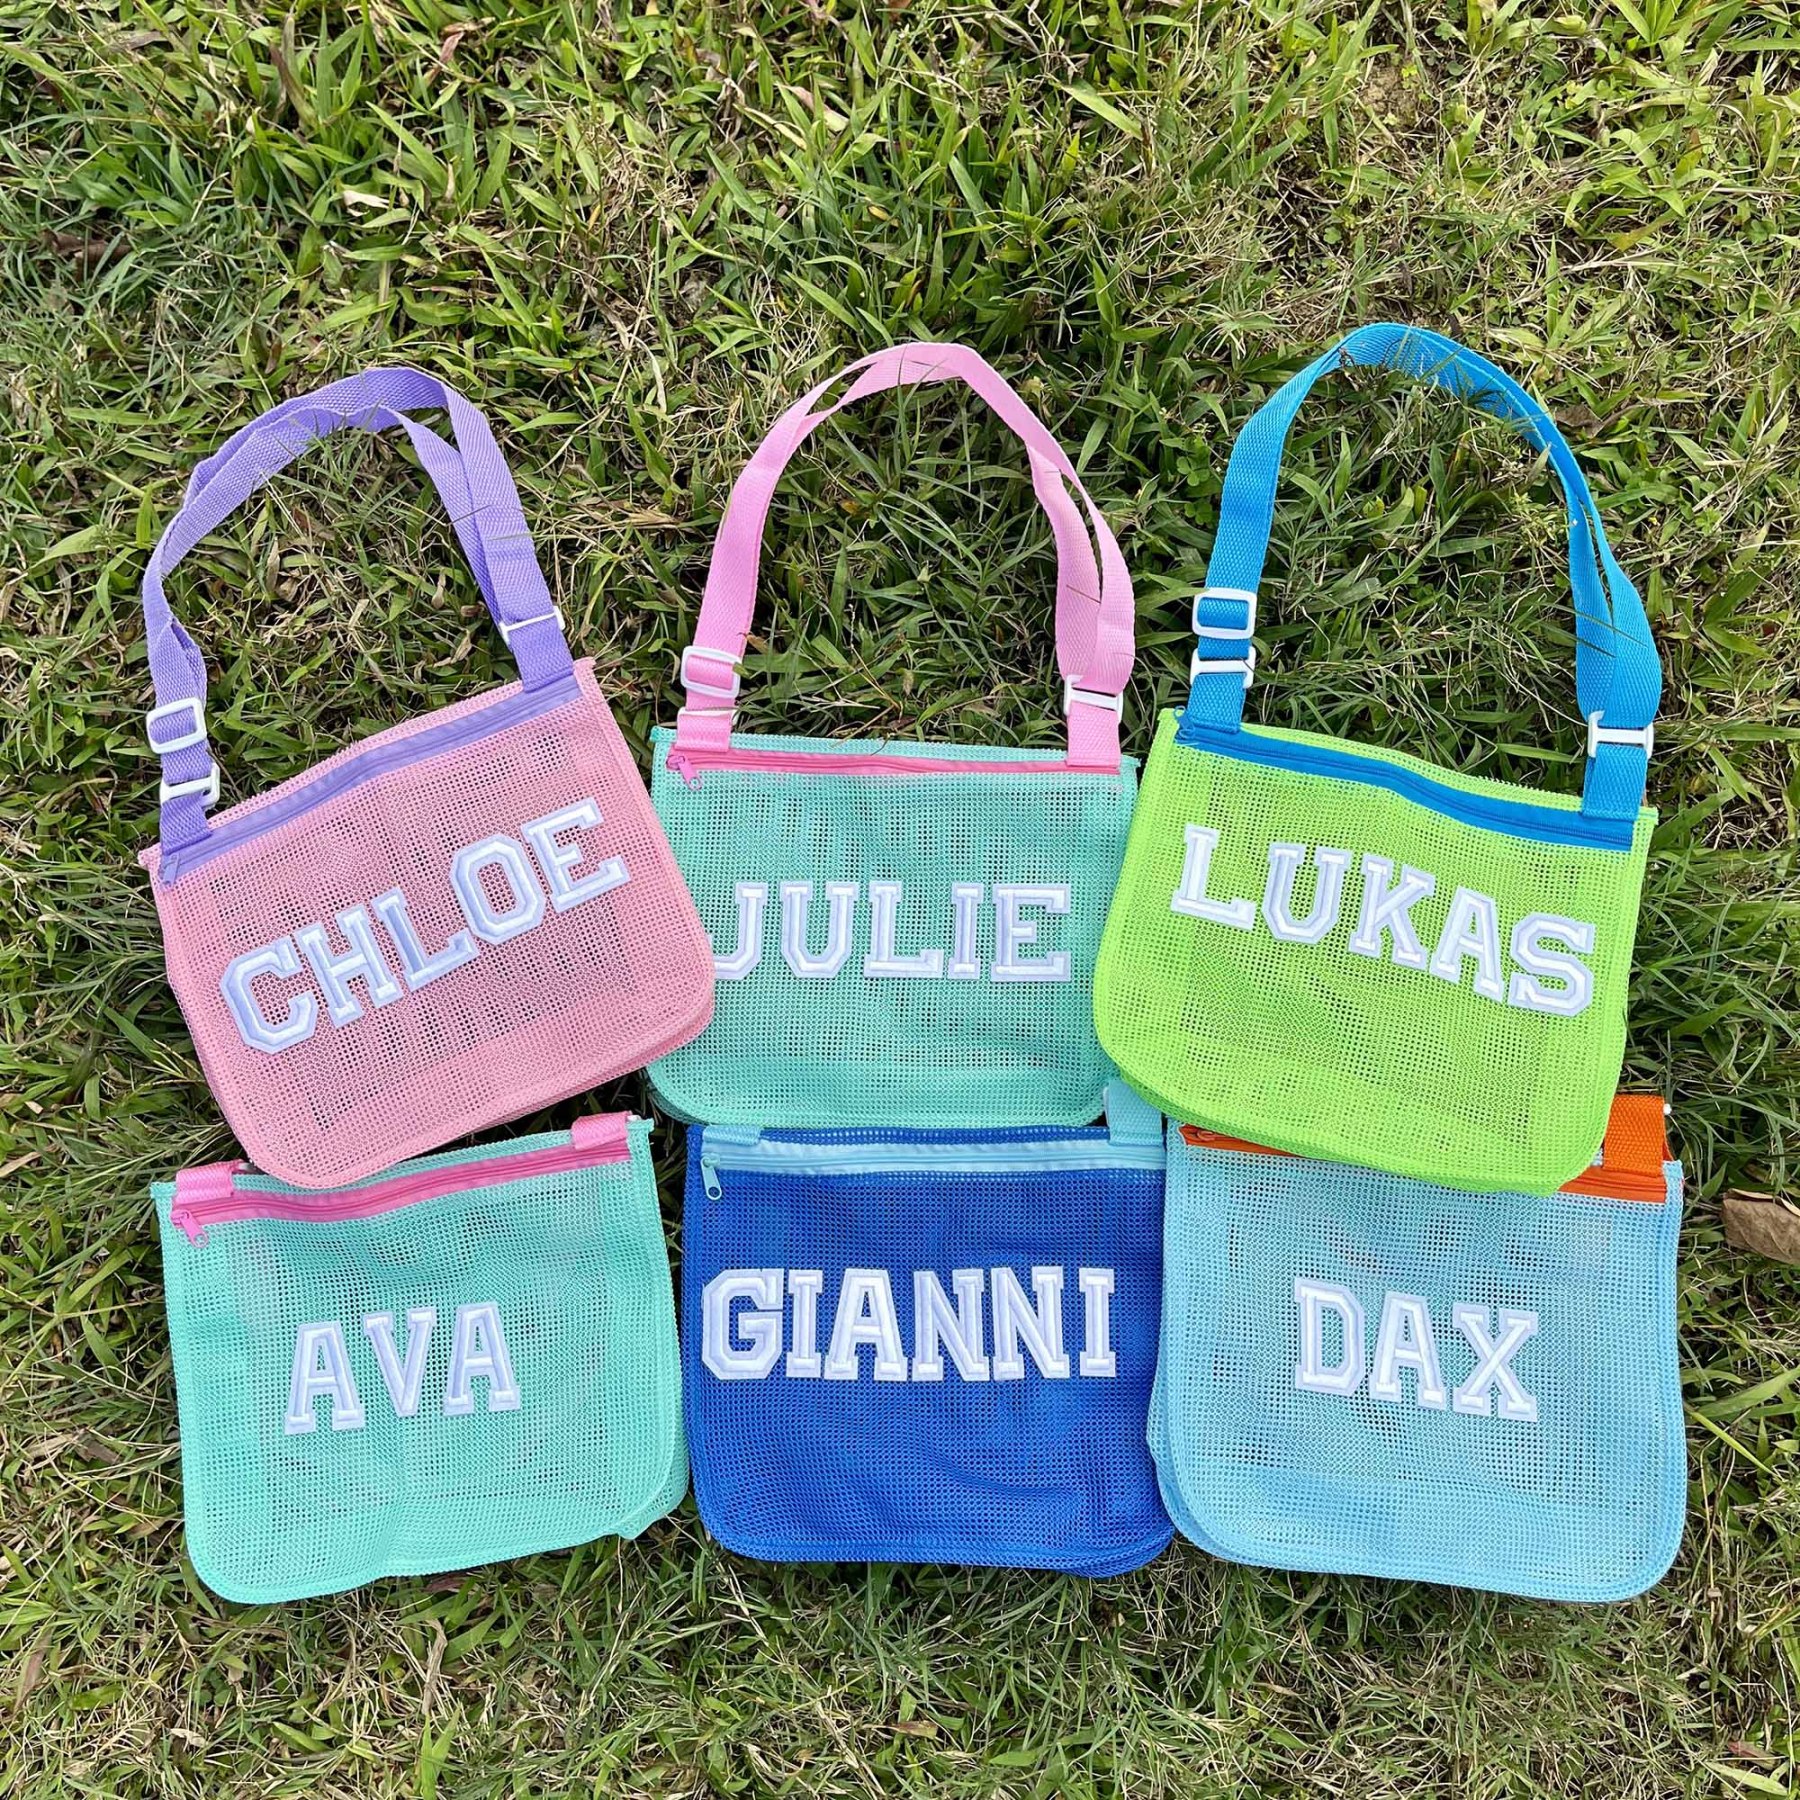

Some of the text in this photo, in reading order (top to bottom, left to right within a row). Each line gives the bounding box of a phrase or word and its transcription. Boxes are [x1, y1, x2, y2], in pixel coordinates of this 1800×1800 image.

[219, 796, 631, 1055] CHLOE
[709, 881, 1071, 982] JULIE
[1171, 823, 1596, 1017] LUKAS
[284, 1301, 521, 1435] AVA
[702, 1266, 1117, 1381] GIANNI
[1294, 1276, 1539, 1422] DAX
